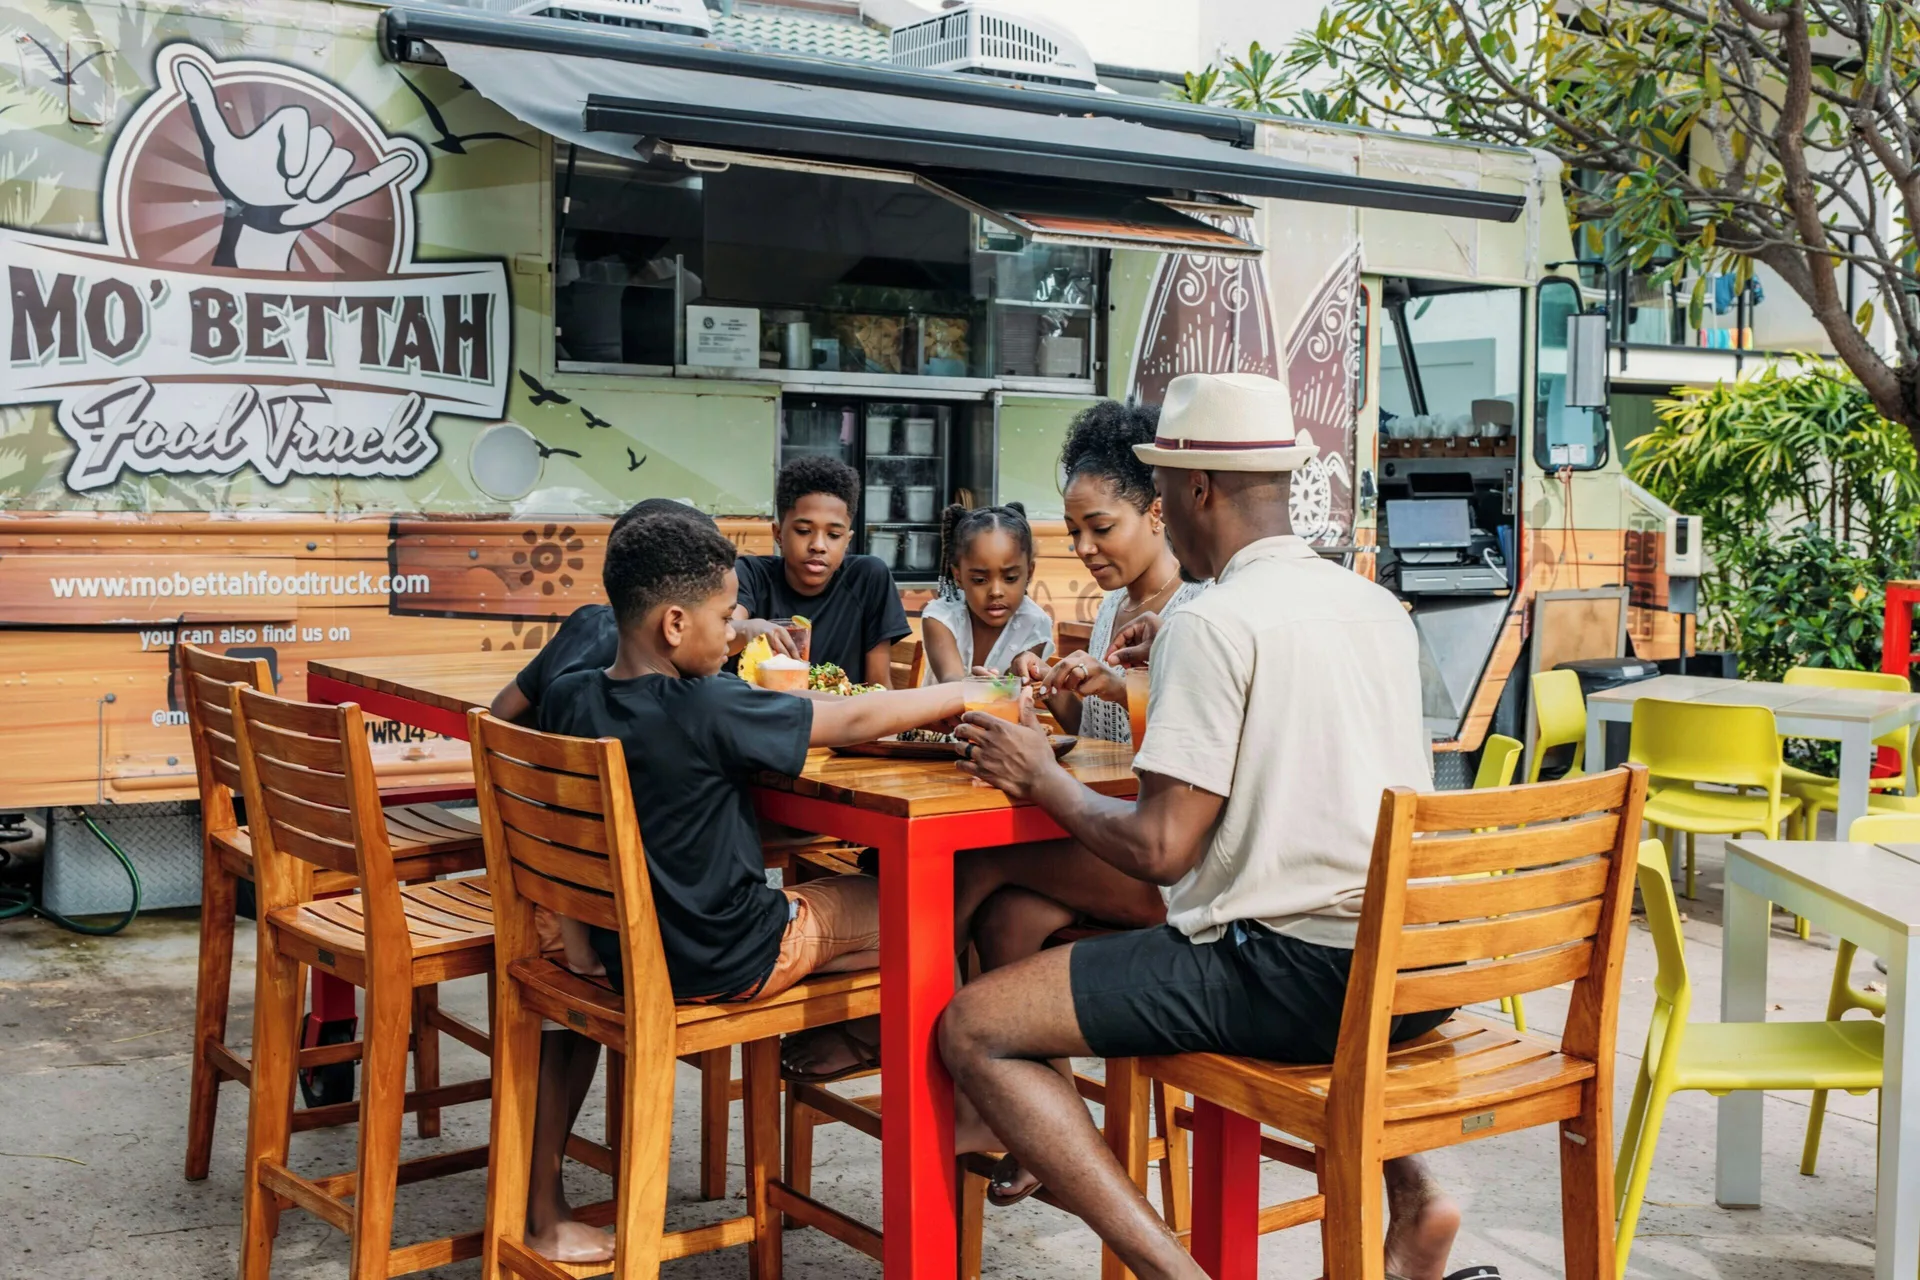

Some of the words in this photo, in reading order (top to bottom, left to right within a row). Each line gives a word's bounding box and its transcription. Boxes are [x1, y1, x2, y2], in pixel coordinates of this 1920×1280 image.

[8, 265, 169, 367] MO'
[188, 286, 497, 387] BETTAH
[72, 376, 259, 477] Food
[258, 383, 430, 470] Truck
[50, 570, 430, 598] www.mobettahfoodtruck.com
[139, 630, 175, 651] you
[180, 629, 214, 644] can
[219, 626, 257, 644] also
[262, 624, 297, 643] find
[302, 627, 324, 642] us
[328, 626, 351, 641] on
